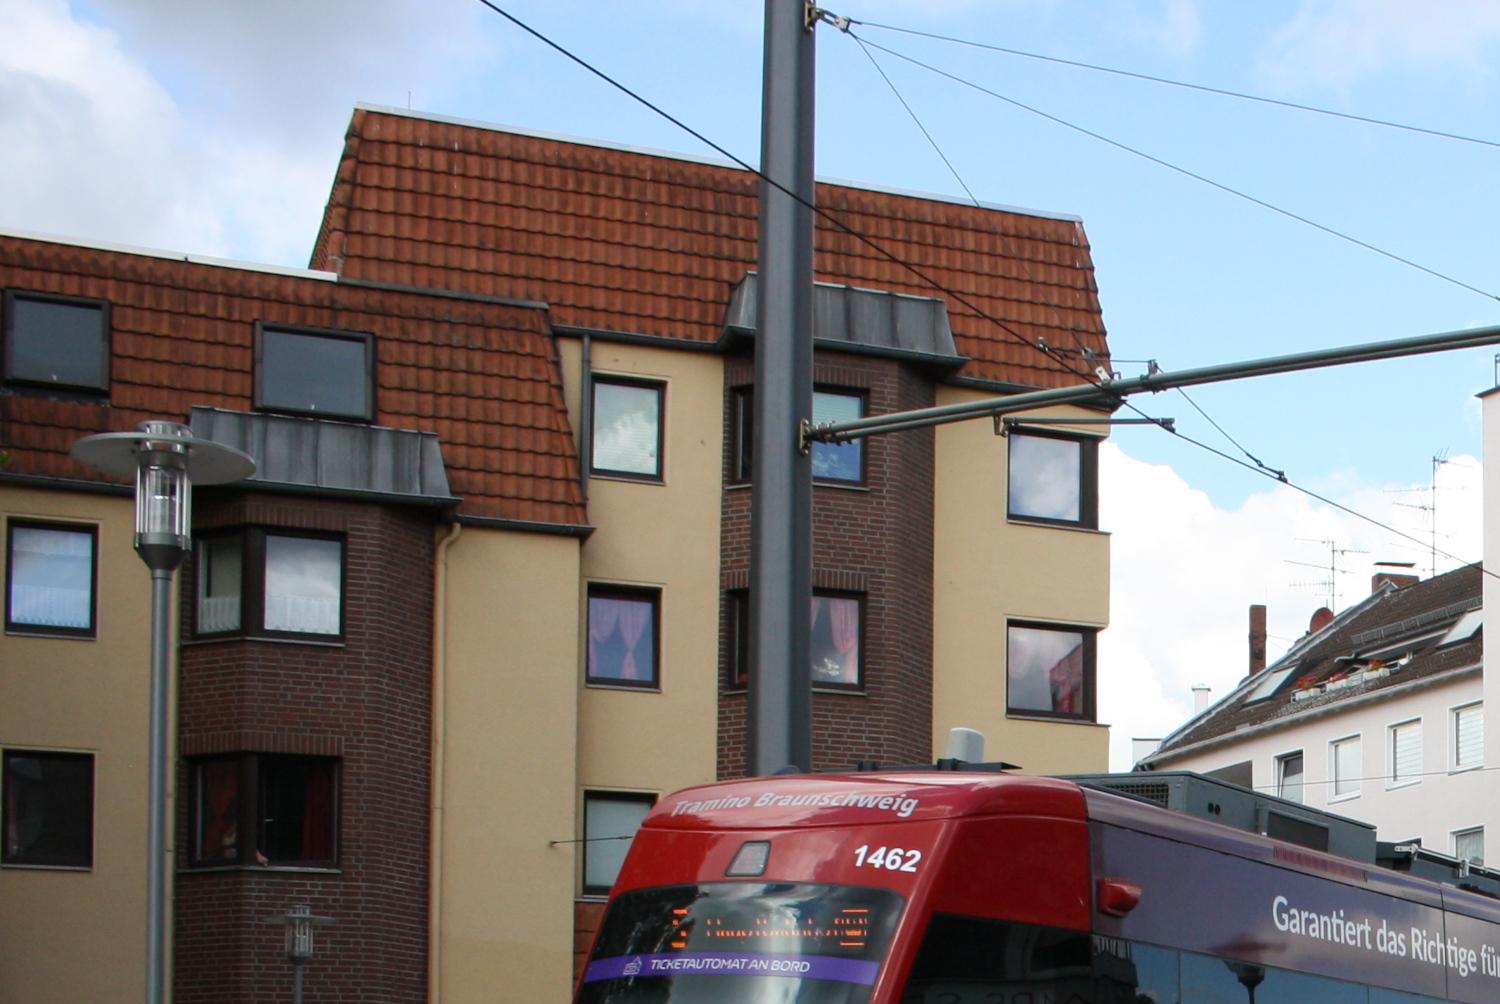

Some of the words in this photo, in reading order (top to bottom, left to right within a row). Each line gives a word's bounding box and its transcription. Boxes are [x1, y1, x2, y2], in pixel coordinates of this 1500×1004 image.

[671, 794, 751, 817] Tramino
[753, 791, 918, 818] Braunschweig
[854, 844, 922, 873] 1462
[1272, 895, 1372, 950] Garantiert
[1376, 919, 1406, 957] das
[1411, 927, 1477, 977] Richtige
[650, 958, 748, 971] TICKETAUTOMAT
[749, 959, 768, 969] AN
[771, 960, 811, 973] BORD
